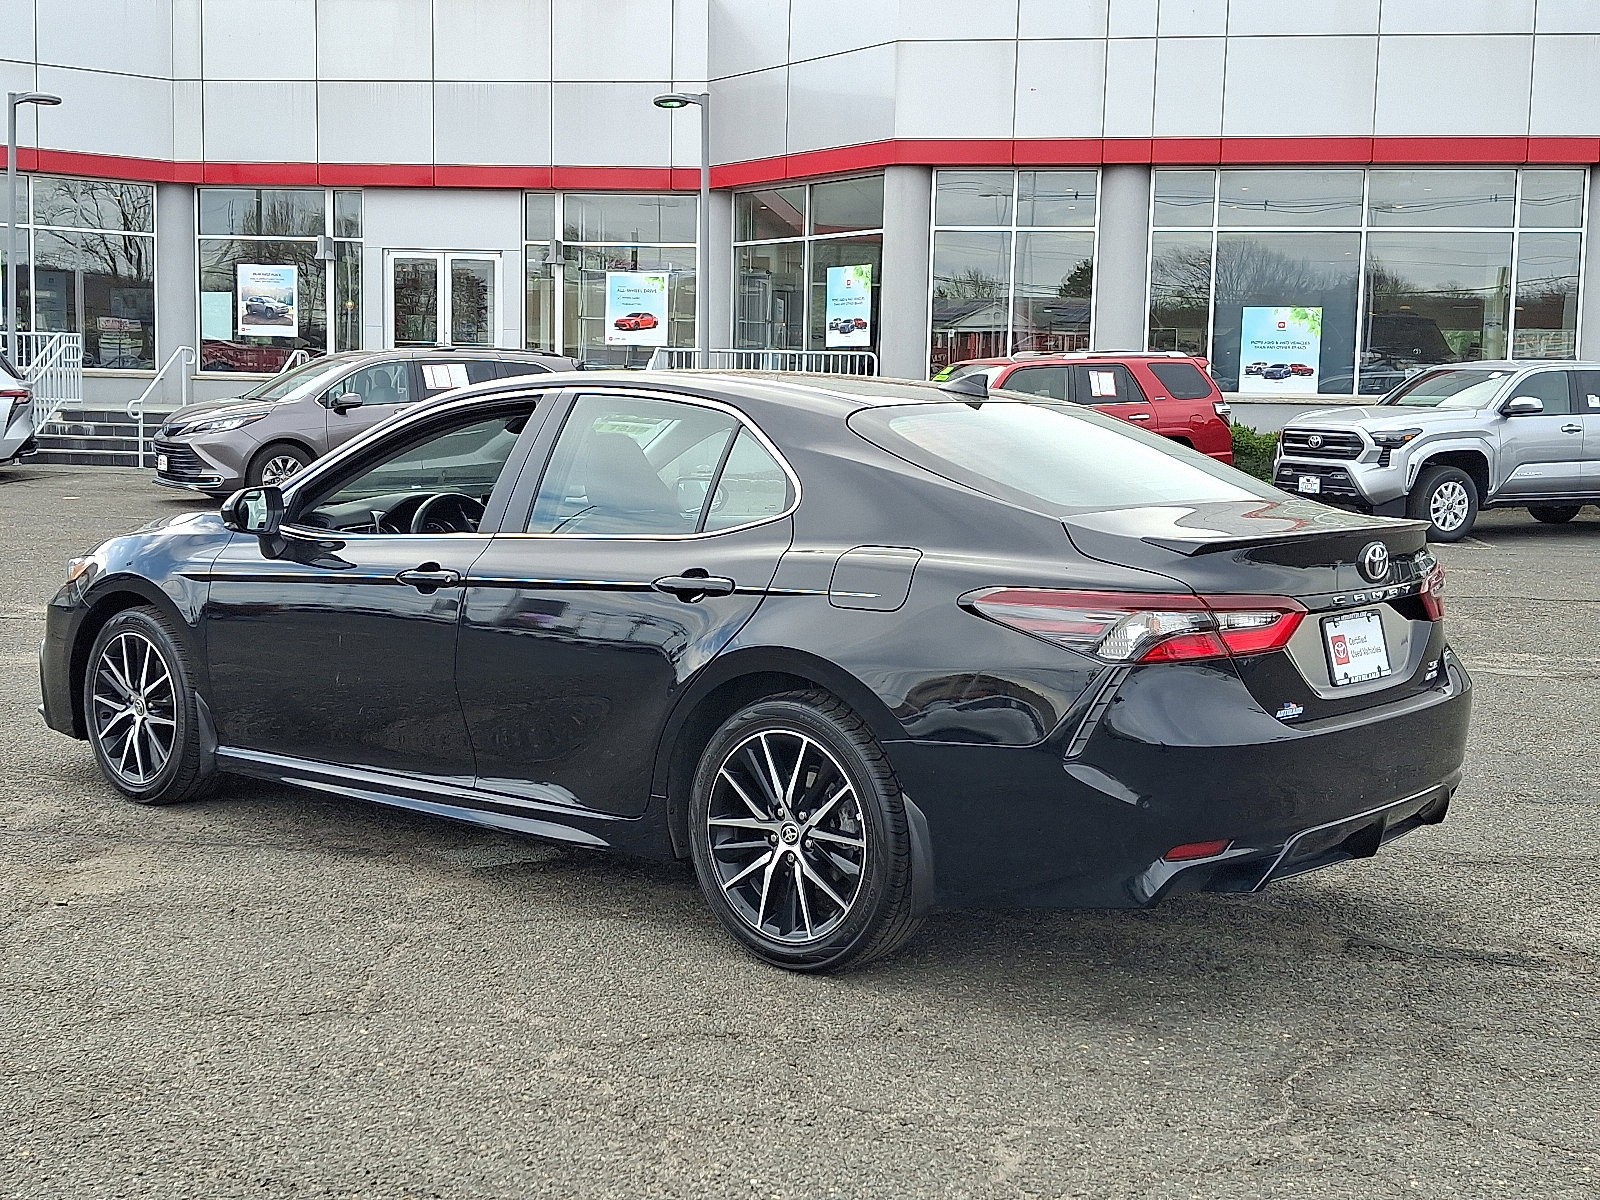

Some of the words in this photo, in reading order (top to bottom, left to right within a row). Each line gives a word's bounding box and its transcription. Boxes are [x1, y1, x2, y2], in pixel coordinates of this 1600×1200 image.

[1332, 585, 1411, 604] CAMRY
[1348, 634, 1368, 646] Certified
[1350, 648, 1363, 658] Used
[1362, 645, 1382, 657] Vehicles
